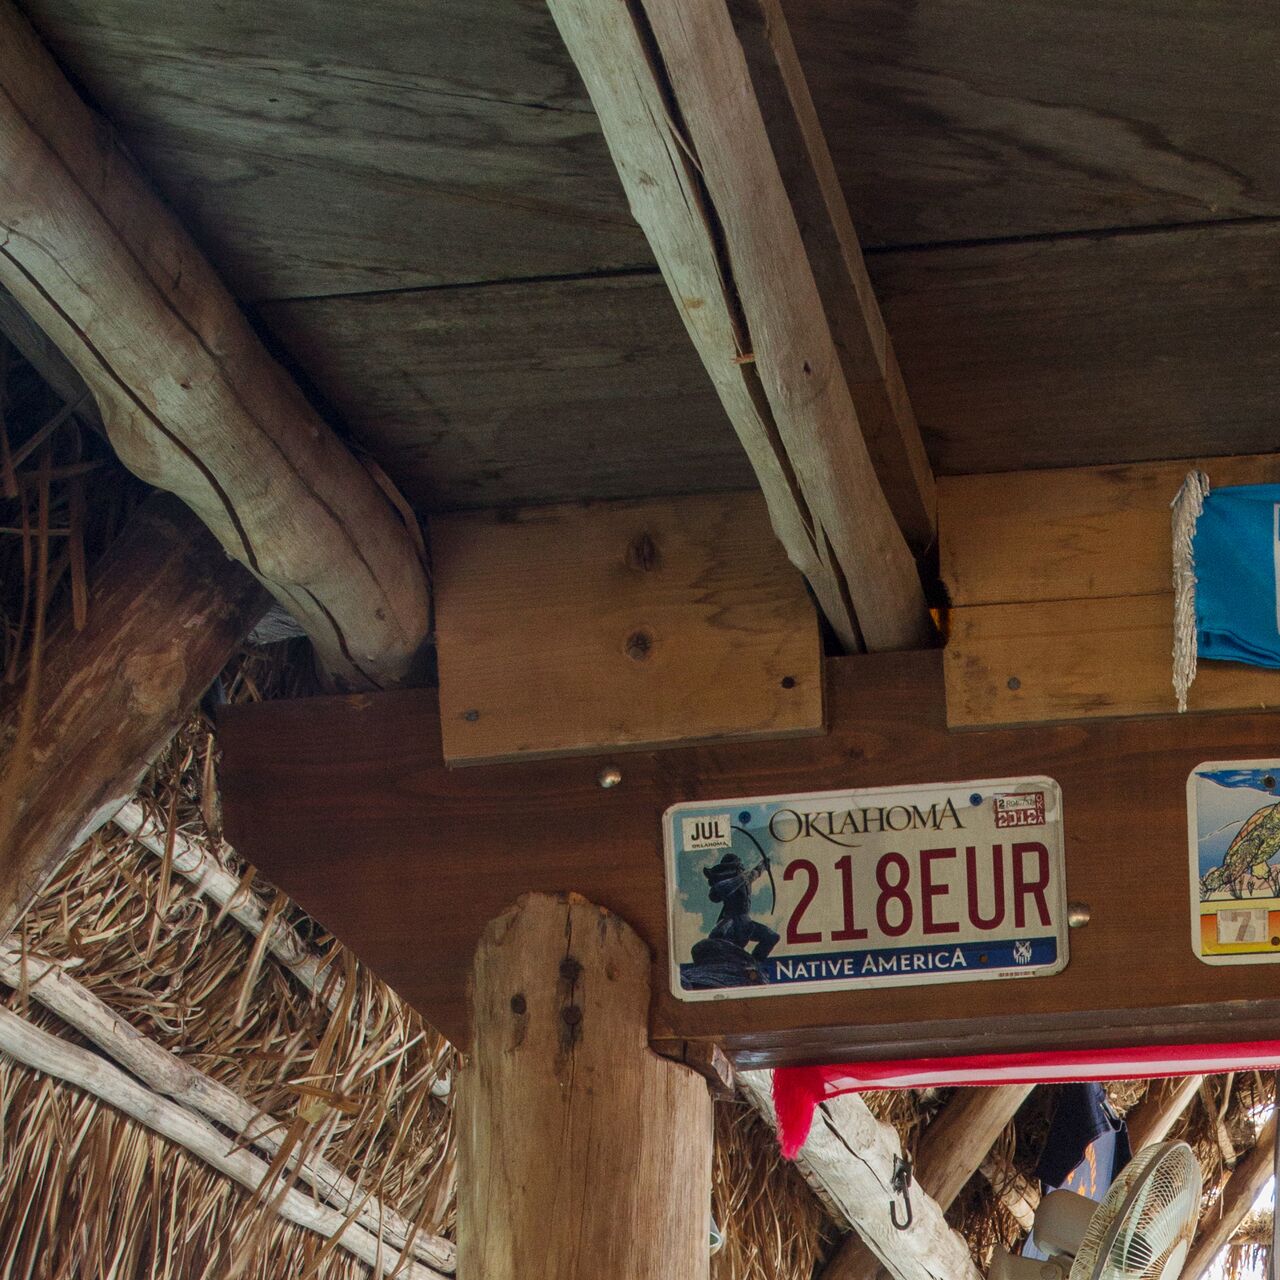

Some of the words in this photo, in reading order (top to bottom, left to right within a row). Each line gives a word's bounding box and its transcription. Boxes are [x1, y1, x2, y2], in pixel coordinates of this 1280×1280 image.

[691, 821, 725, 841] JUL
[769, 797, 967, 848] OKLAHOMA
[998, 809, 1037, 827] 2012
[783, 842, 1052, 945] 218EUR
[776, 954, 855, 981] NATIVE
[861, 948, 967, 974] AMERICA
